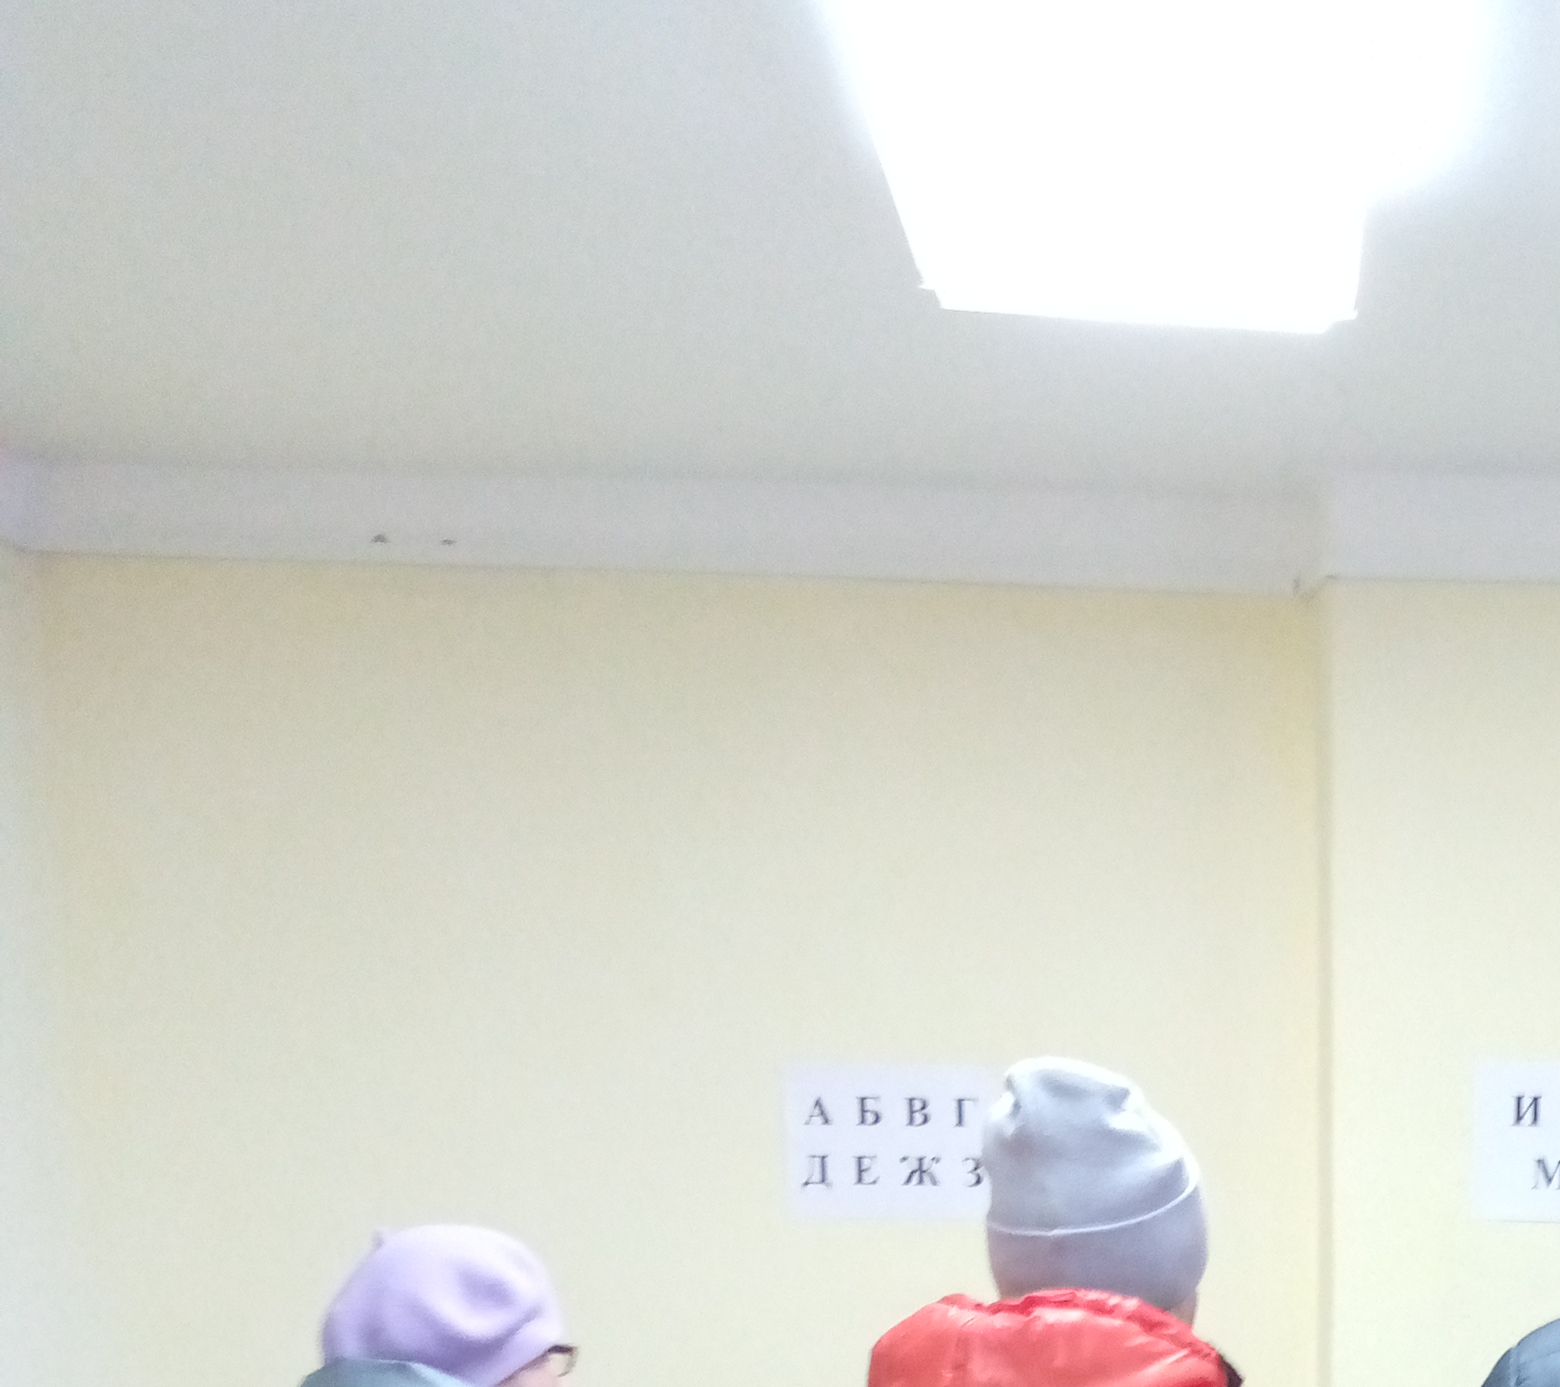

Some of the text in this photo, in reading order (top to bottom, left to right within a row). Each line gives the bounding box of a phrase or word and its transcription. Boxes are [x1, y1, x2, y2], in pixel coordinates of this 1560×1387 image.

[804, 1096, 979, 1128] А Б В Г
[1511, 1095, 1542, 1127] И
[801, 1154, 832, 1188] Д
[853, 1155, 880, 1186] Е
[899, 1156, 942, 1187] Ж
